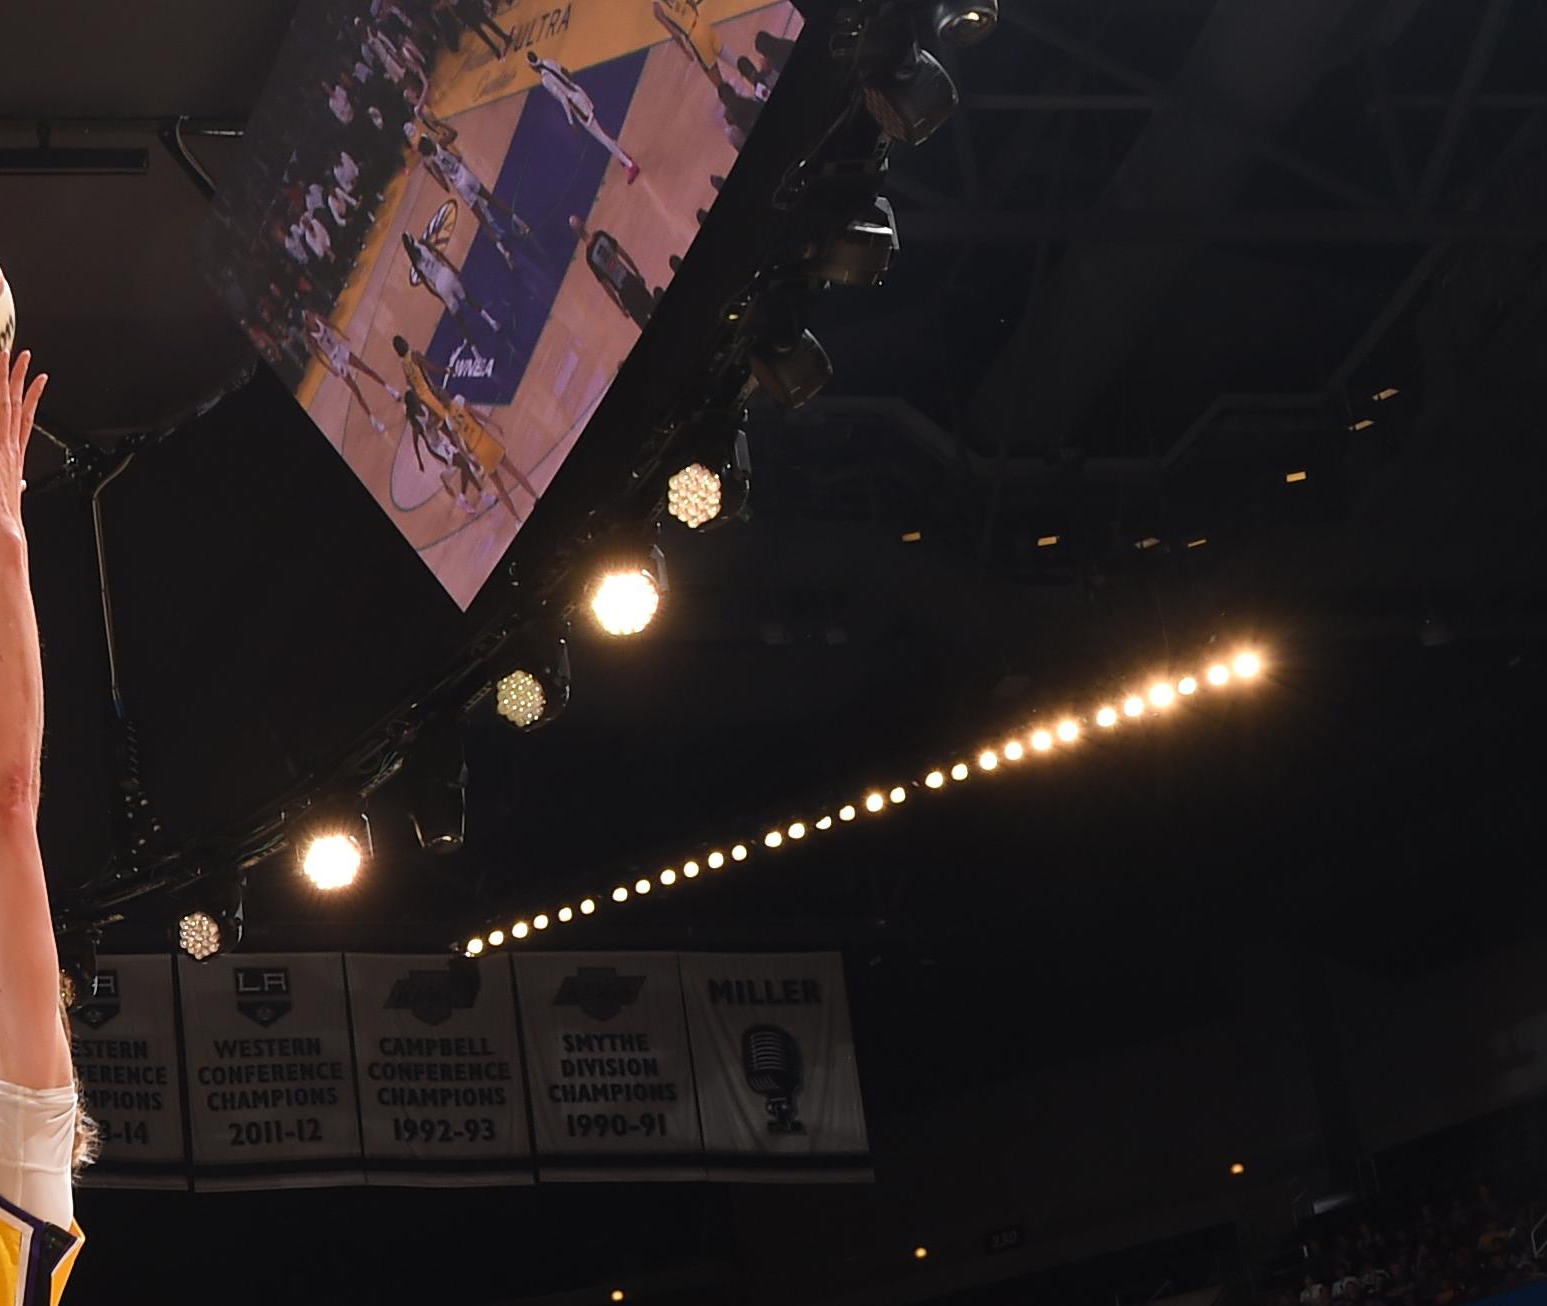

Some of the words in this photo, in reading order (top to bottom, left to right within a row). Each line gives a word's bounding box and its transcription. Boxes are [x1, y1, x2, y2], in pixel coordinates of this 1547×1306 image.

[708, 978, 825, 1005] MILLER
[73, 1040, 147, 1059] ESTERN
[214, 1038, 321, 1058] WESTERN
[379, 1036, 494, 1057] CAMPBELL
[562, 1033, 651, 1052] SMYTHE
[79, 1064, 167, 1085] FERENCE
[197, 1062, 343, 1086] CONFERENCE
[367, 1061, 512, 1081] CONFERENCE
[560, 1058, 658, 1078] DIVISION
[206, 1087, 338, 1111] CHAMPIONS
[377, 1086, 507, 1107] CHAMPIONS
[548, 1082, 677, 1103] CHAMPIONS
[228, 1117, 323, 1146] 2011-12
[392, 1117, 497, 1142] 1992-93
[567, 1112, 668, 1138] 1990-91
